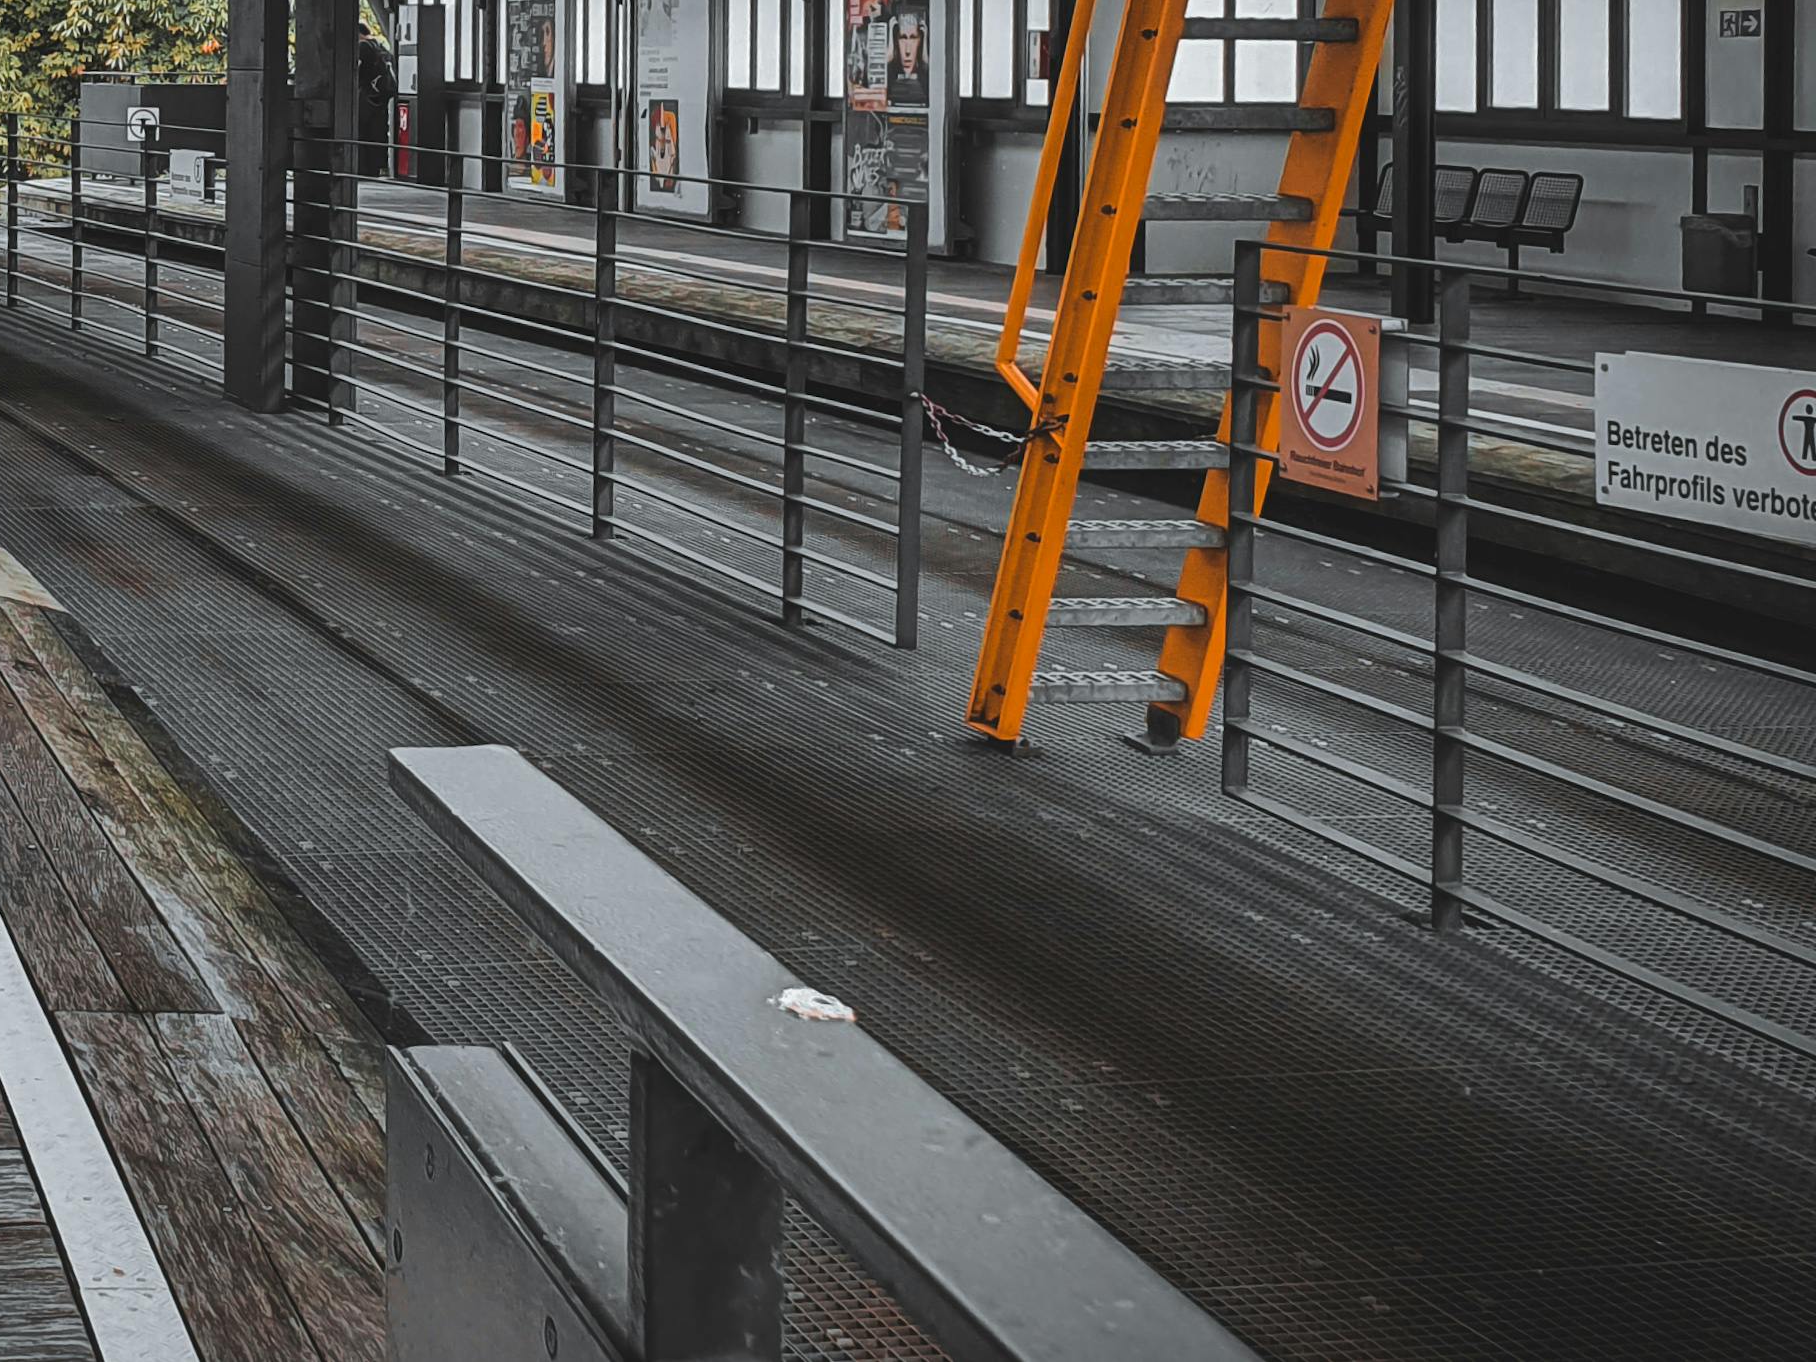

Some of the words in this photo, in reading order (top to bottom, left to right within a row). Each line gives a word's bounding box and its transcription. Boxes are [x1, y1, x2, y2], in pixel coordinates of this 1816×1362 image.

[1607, 420, 1698, 459] Betreten
[1705, 435, 1747, 466] des
[1608, 460, 1725, 505] Fahrprofils
